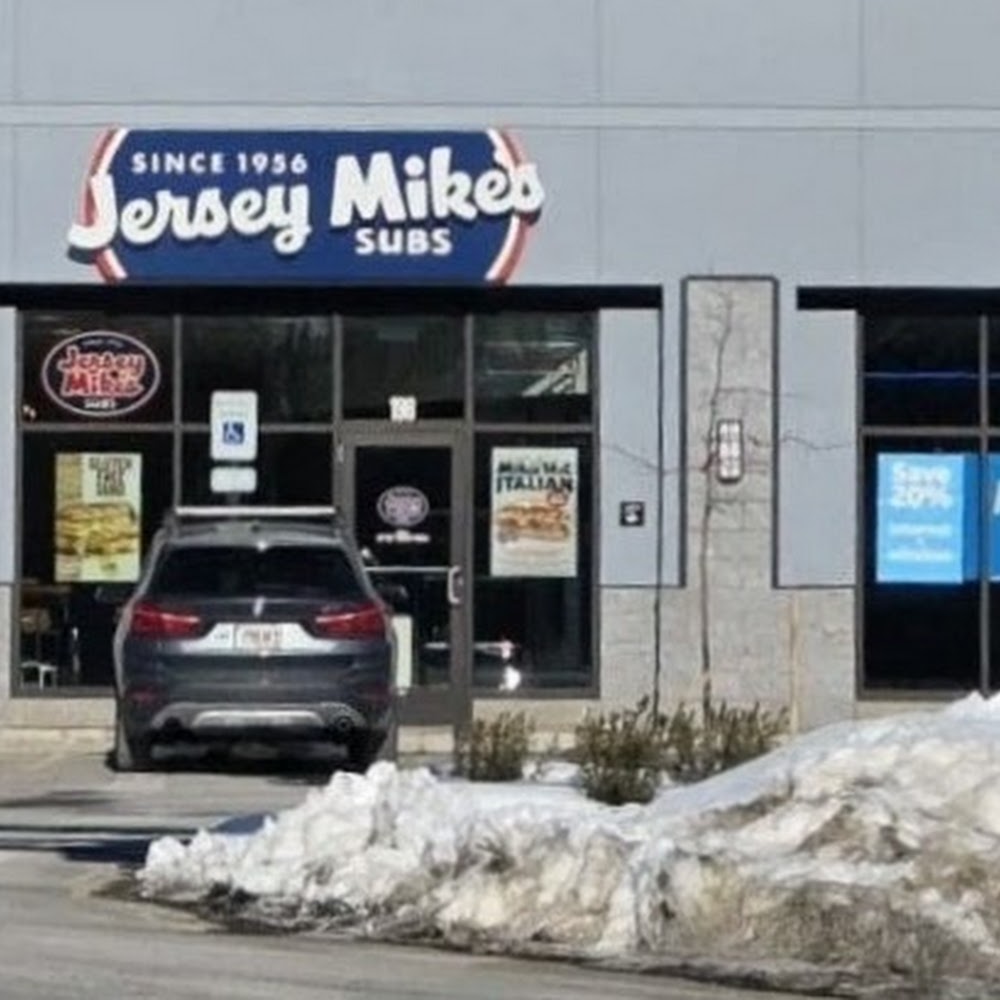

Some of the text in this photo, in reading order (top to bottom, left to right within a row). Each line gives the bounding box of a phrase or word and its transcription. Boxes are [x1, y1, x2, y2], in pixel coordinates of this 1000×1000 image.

[131, 152, 309, 174] SINCE 1956
[67, 146, 547, 255] Jersey Mike's
[354, 227, 453, 256] SUBS
[496, 475, 573, 492] ITALIAN
